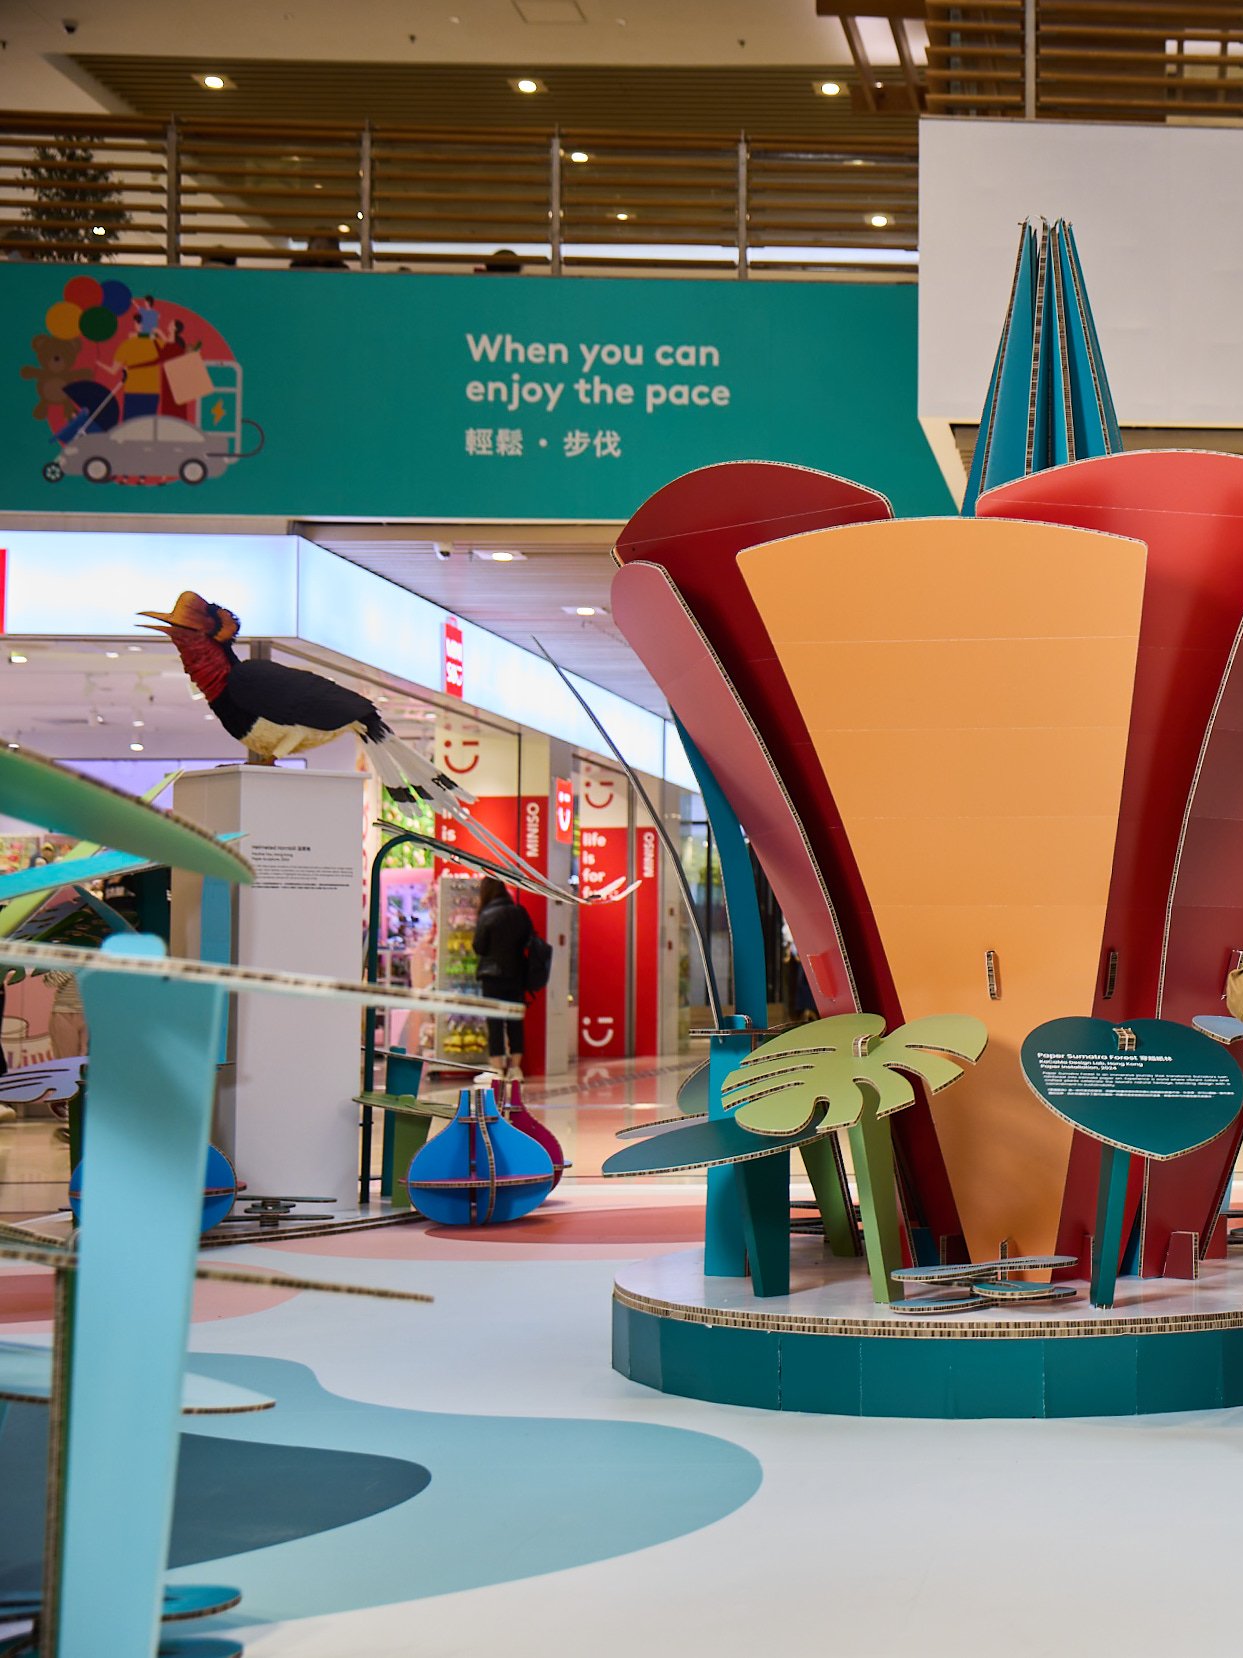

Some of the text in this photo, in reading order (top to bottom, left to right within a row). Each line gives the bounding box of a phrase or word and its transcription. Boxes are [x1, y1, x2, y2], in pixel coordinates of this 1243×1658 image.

[466, 333, 720, 373] When you can
[466, 373, 731, 414] enjoy the pace
[441, 825, 457, 842] is
[525, 802, 540, 858] MINISO
[582, 831, 607, 847] life
[582, 850, 596, 865] is
[642, 831, 655, 878] MINISO
[582, 867, 606, 883] for
[1037, 1052, 1065, 1060] Paper
[1066, 1053, 1108, 1061] Sumatra
